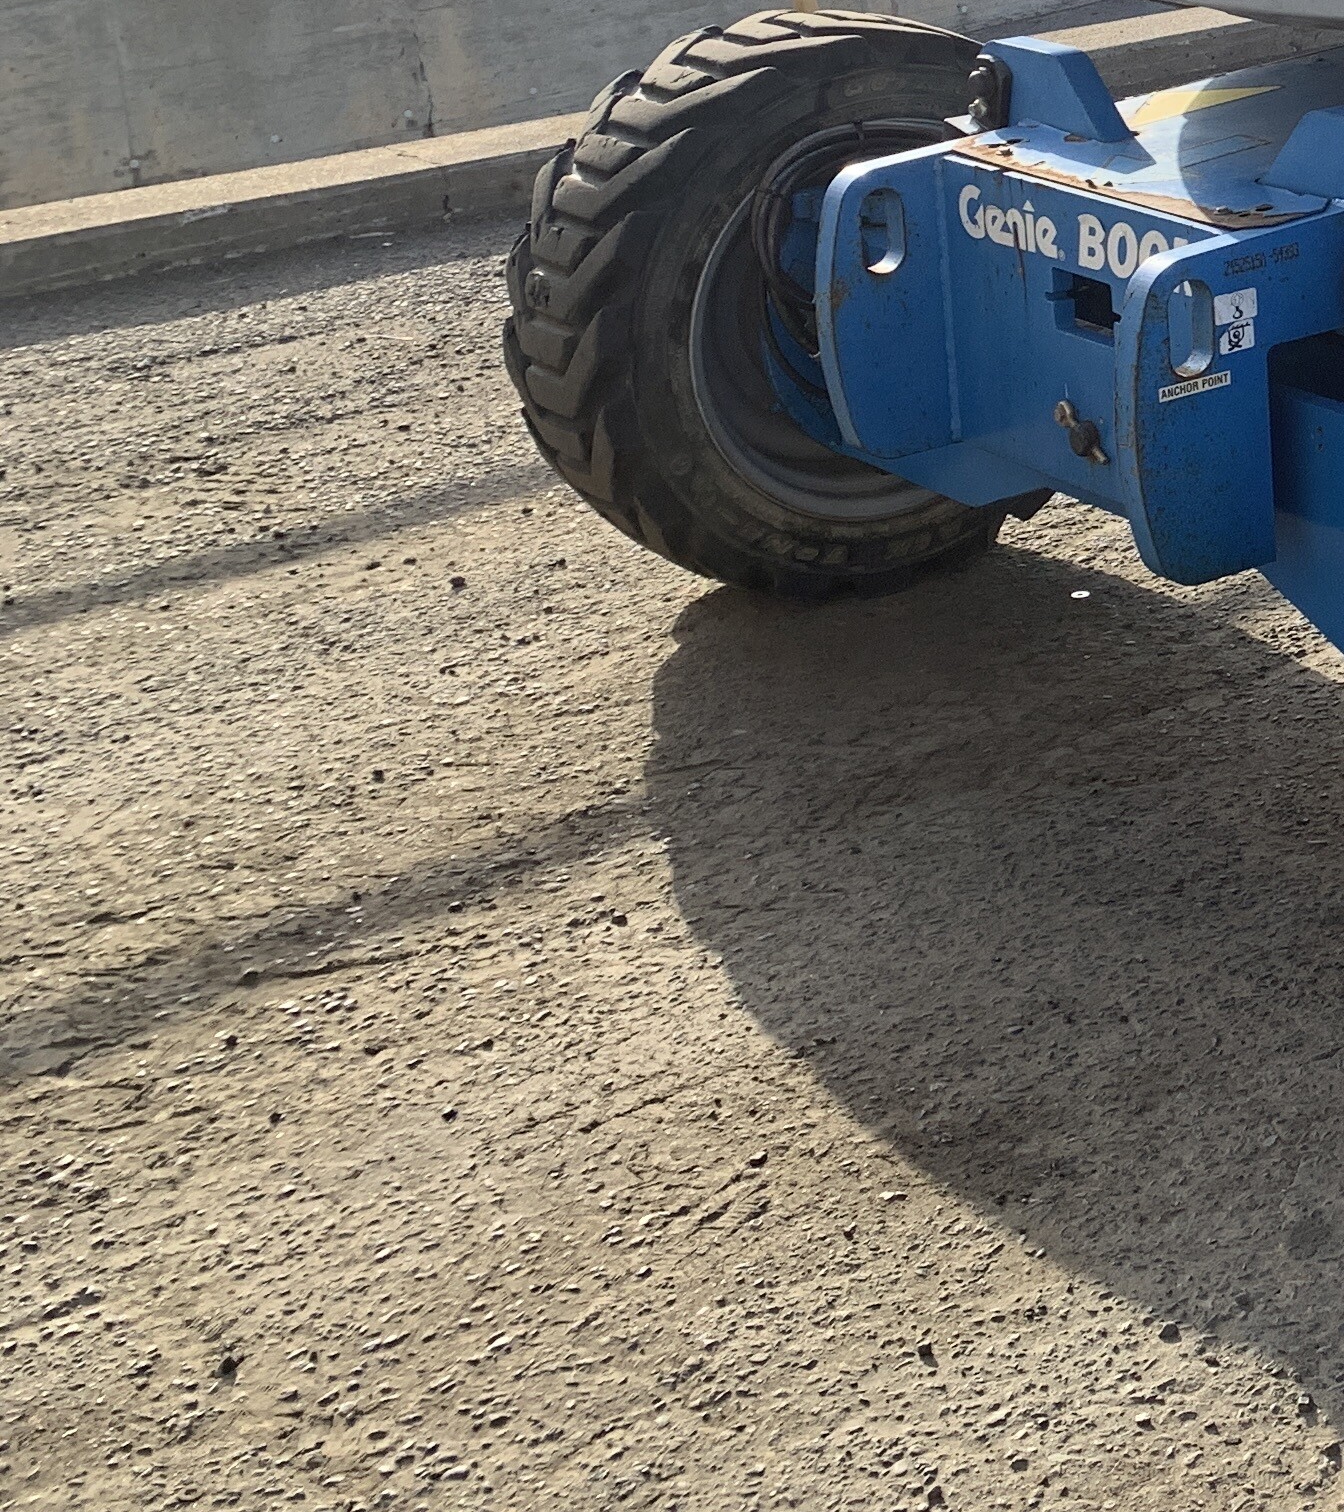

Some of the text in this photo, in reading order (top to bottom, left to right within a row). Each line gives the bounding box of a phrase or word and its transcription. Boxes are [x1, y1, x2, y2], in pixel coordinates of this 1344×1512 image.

[958, 184, 1059, 260] Genie
[1077, 213, 1190, 279] BOO
[1160, 372, 1230, 400] ANCHOR POINT
